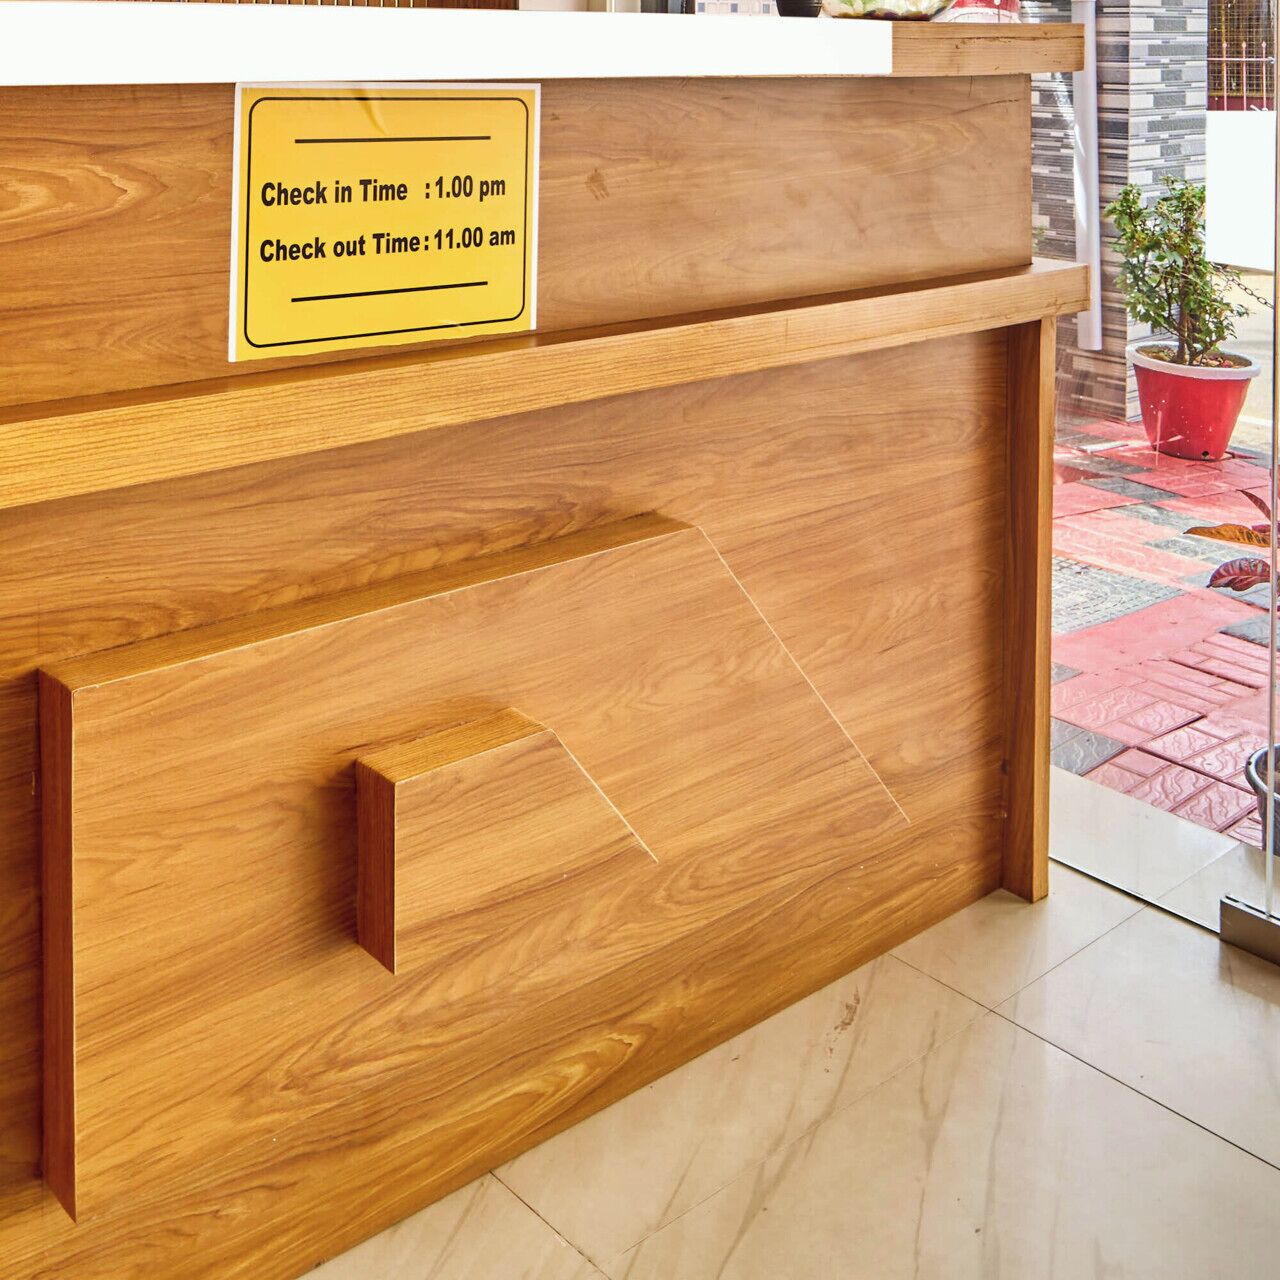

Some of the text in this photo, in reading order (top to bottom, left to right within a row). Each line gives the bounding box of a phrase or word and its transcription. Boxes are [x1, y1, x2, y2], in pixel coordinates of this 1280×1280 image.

[261, 180, 327, 207] Check
[334, 179, 352, 203] in
[479, 179, 506, 203] pm
[260, 236, 326, 263] Check
[333, 234, 366, 258] out
[489, 228, 516, 247] am
